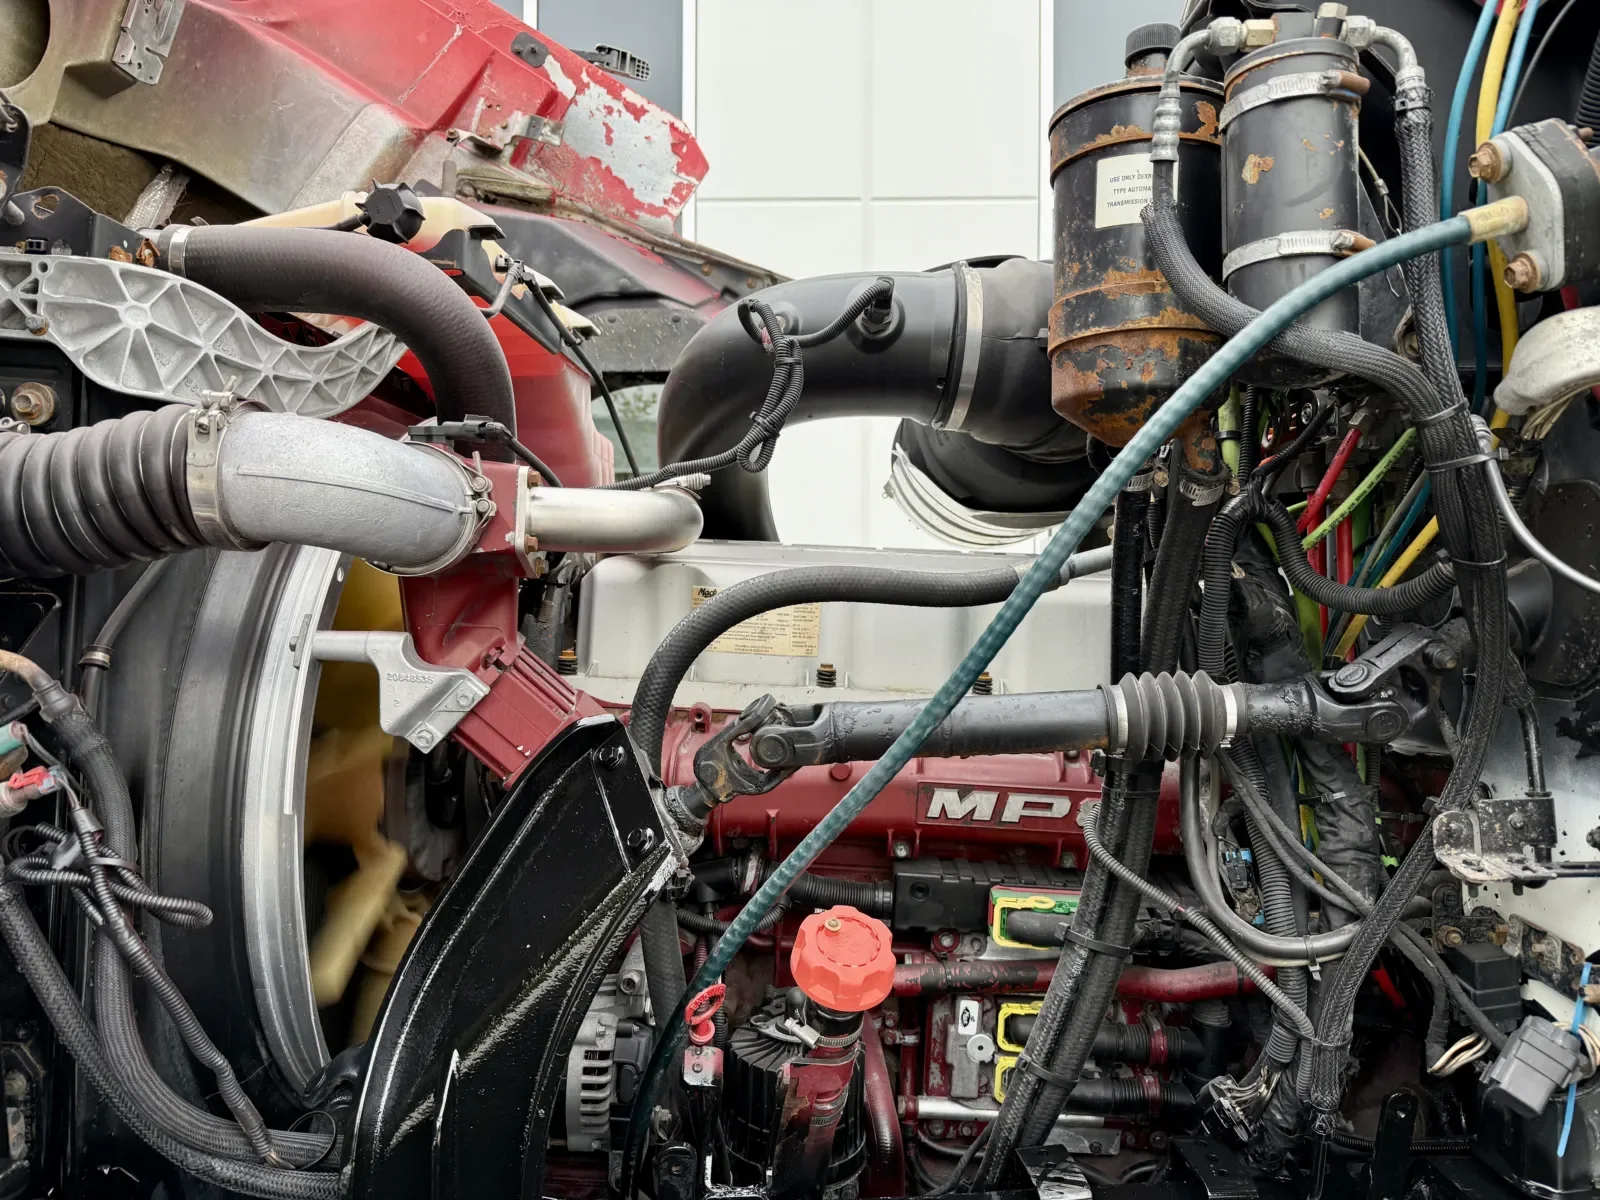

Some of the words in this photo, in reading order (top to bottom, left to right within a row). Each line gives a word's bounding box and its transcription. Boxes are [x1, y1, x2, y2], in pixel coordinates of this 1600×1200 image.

[1109, 175, 1120, 183] USE
[1121, 174, 1136, 182] ONLY
[1113, 187, 1126, 195] TYPE
[1128, 185, 1153, 193] AUTOMA
[1106, 198, 1148, 208] TRANSMISSION
